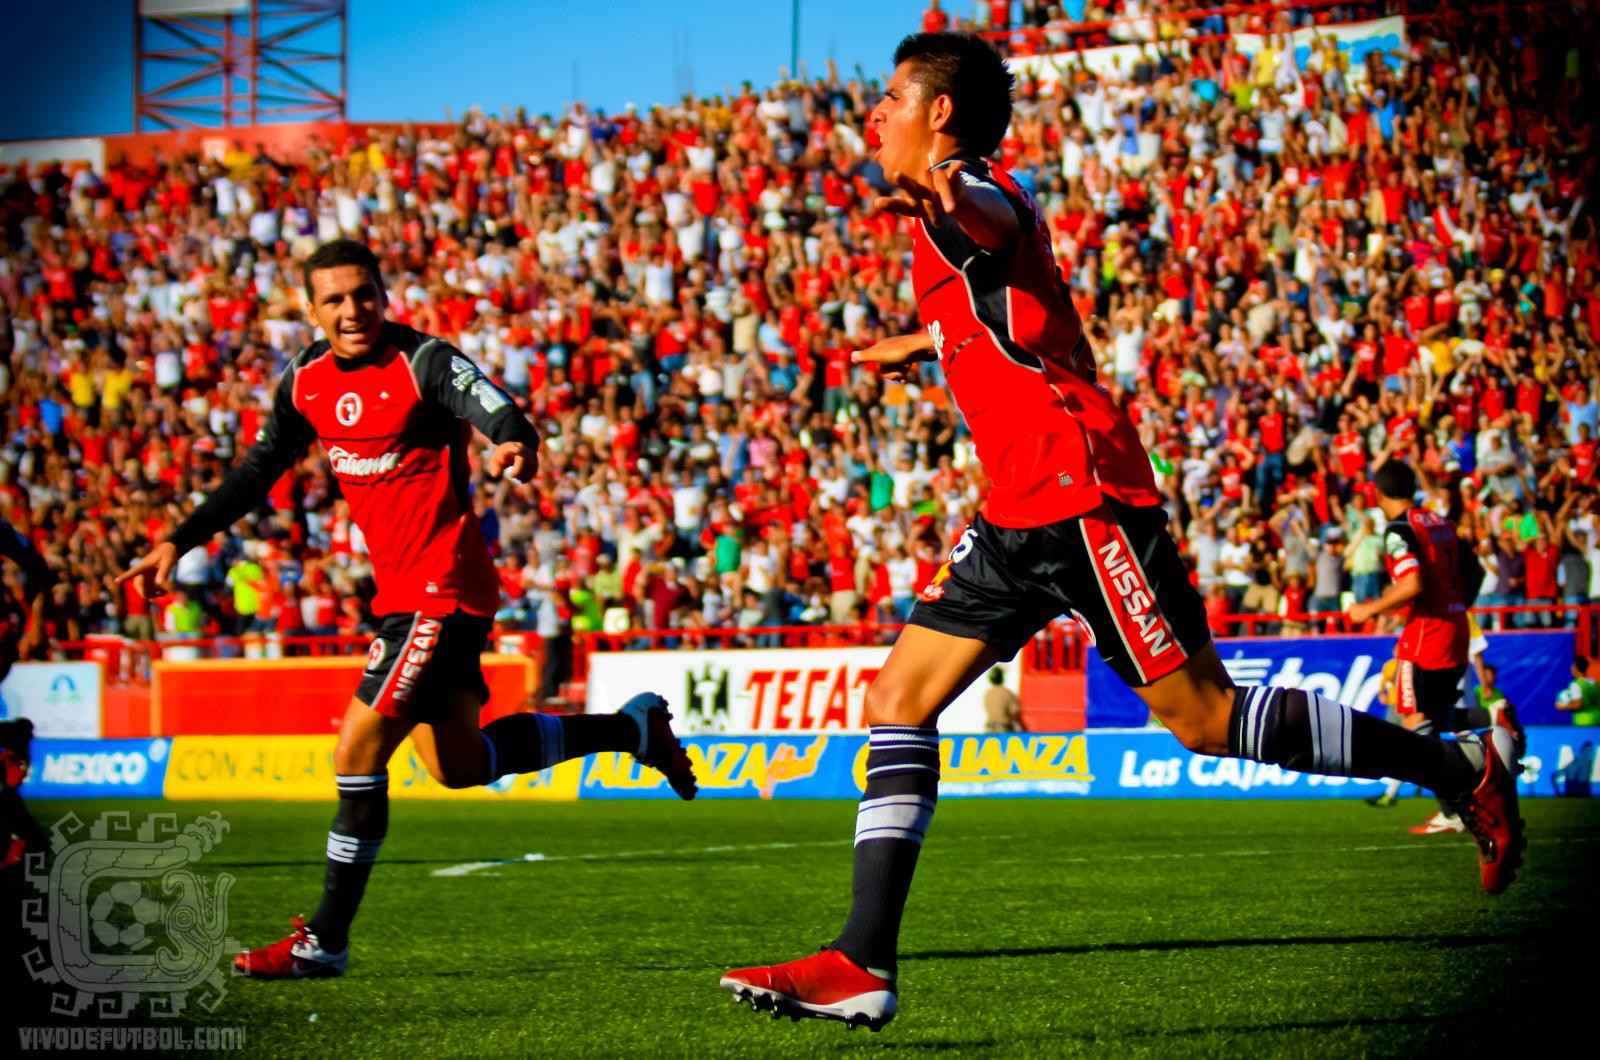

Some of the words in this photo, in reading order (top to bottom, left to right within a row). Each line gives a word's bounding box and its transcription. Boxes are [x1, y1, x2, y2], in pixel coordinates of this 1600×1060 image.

[1098, 539, 1172, 658] NISSAN
[391, 618, 442, 701] NISSAN
[744, 664, 883, 730] TECAT
[174, 750, 237, 781] CON
[938, 736, 1090, 774] LIANZA
[1119, 751, 1182, 787] Las
